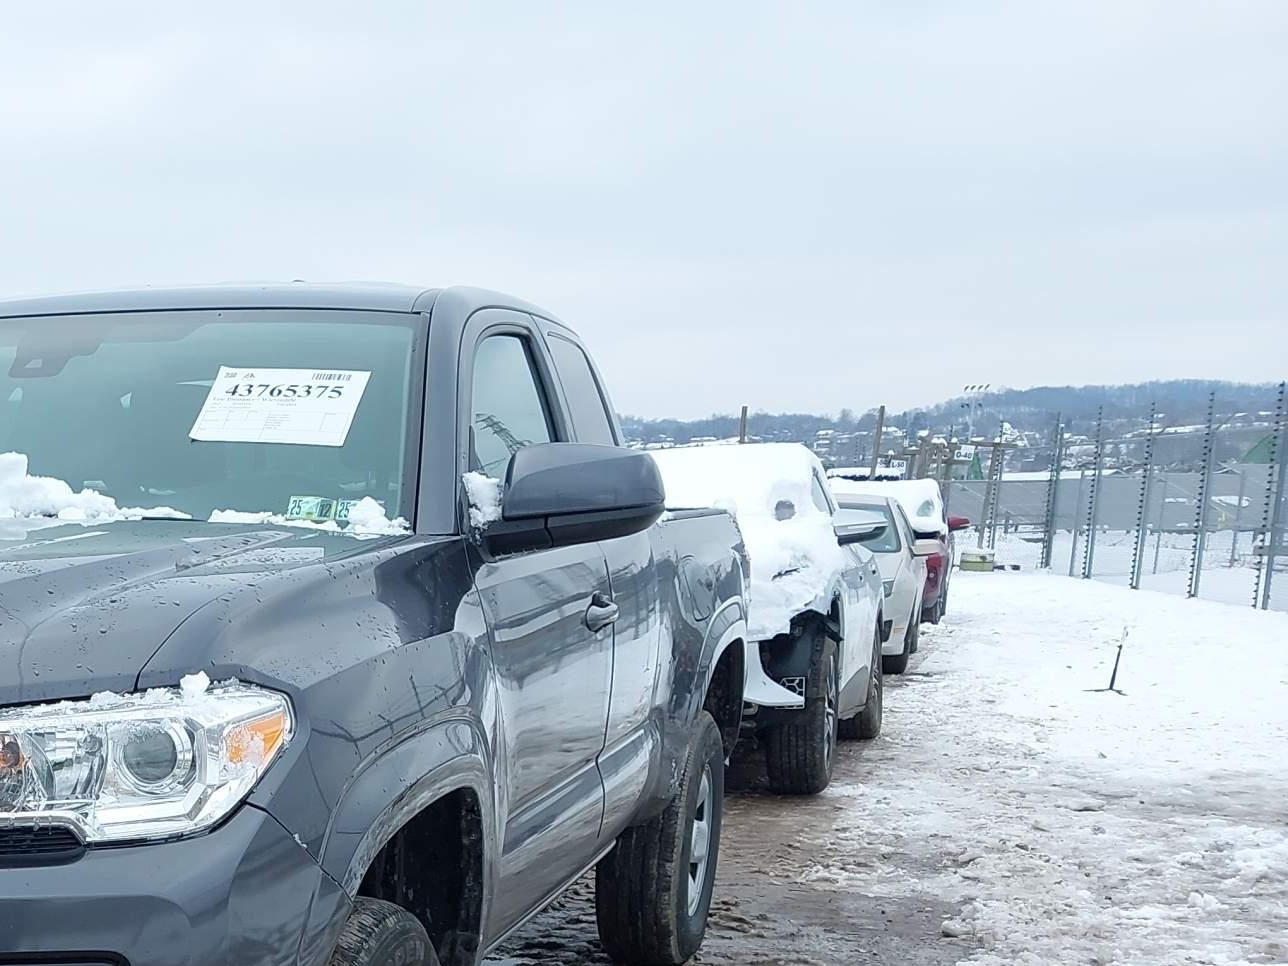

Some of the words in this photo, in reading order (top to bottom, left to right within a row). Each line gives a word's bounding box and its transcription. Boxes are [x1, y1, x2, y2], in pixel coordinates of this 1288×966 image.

[225, 383, 344, 399] 43765375
[290, 499, 302, 516] 25
[318, 502, 332, 518] 12
[338, 501, 350, 518] 25
